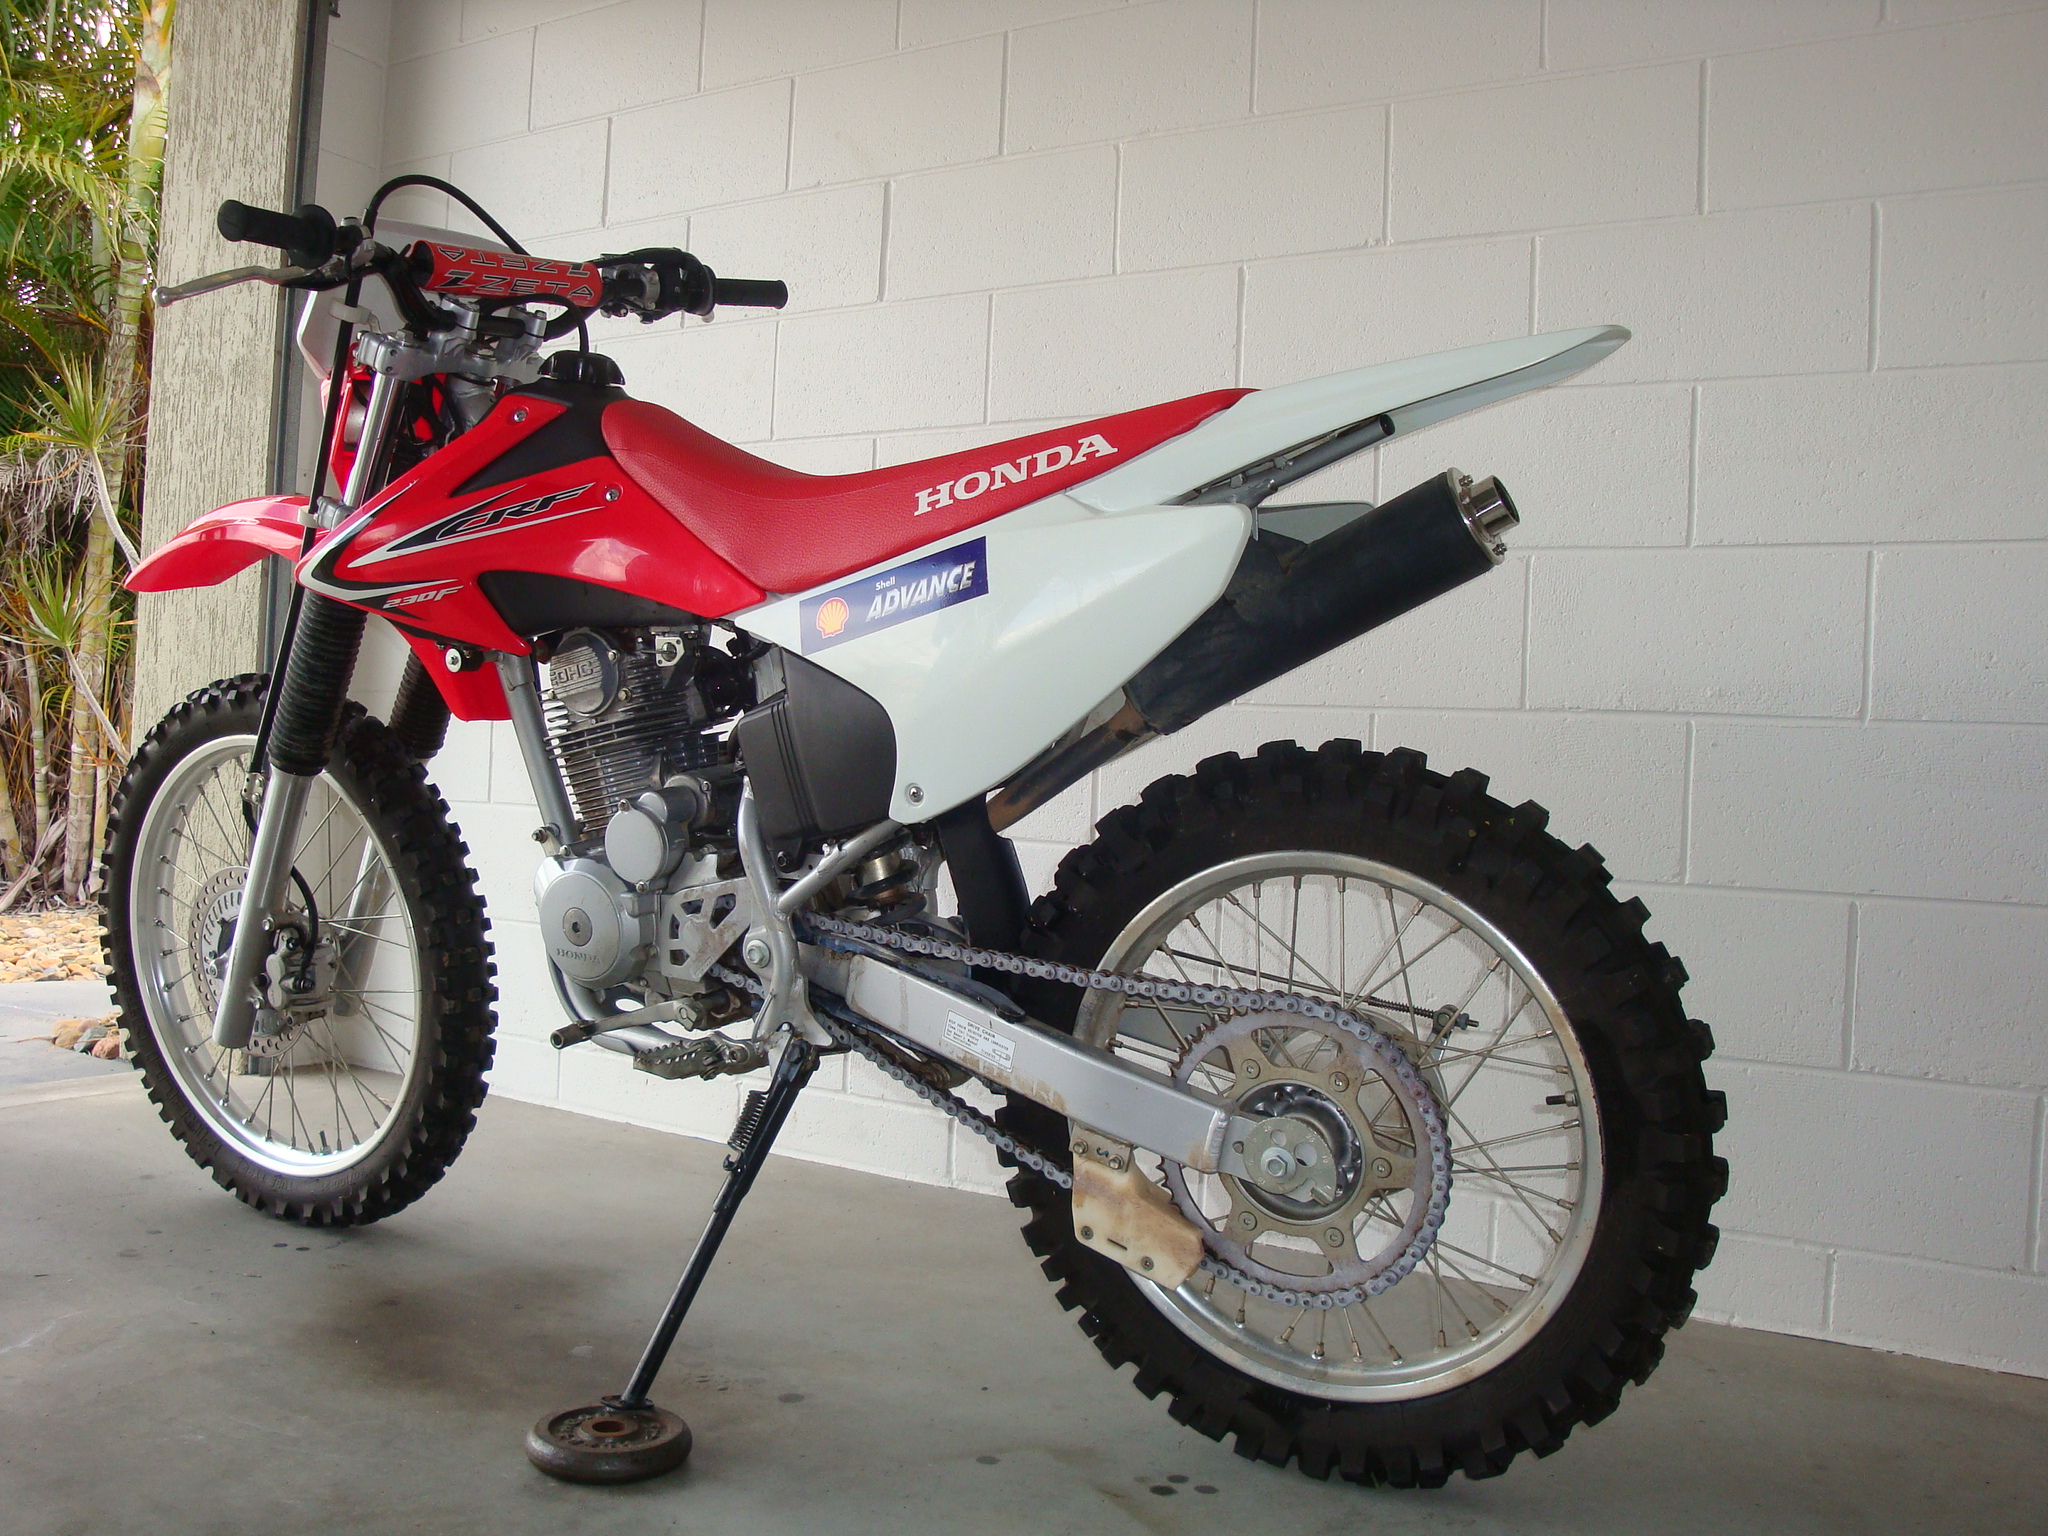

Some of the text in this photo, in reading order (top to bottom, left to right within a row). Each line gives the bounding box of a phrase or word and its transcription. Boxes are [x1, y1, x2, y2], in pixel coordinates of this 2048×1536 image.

[438, 246, 558, 275] ZETA
[478, 275, 594, 300] ZETA
[914, 433, 1118, 516] HONDA
[435, 482, 596, 540] CRF
[382, 585, 464, 609] 230F
[865, 560, 977, 623] ADVANCE
[875, 576, 895, 591] Shell
[556, 948, 600, 964] HONDA
